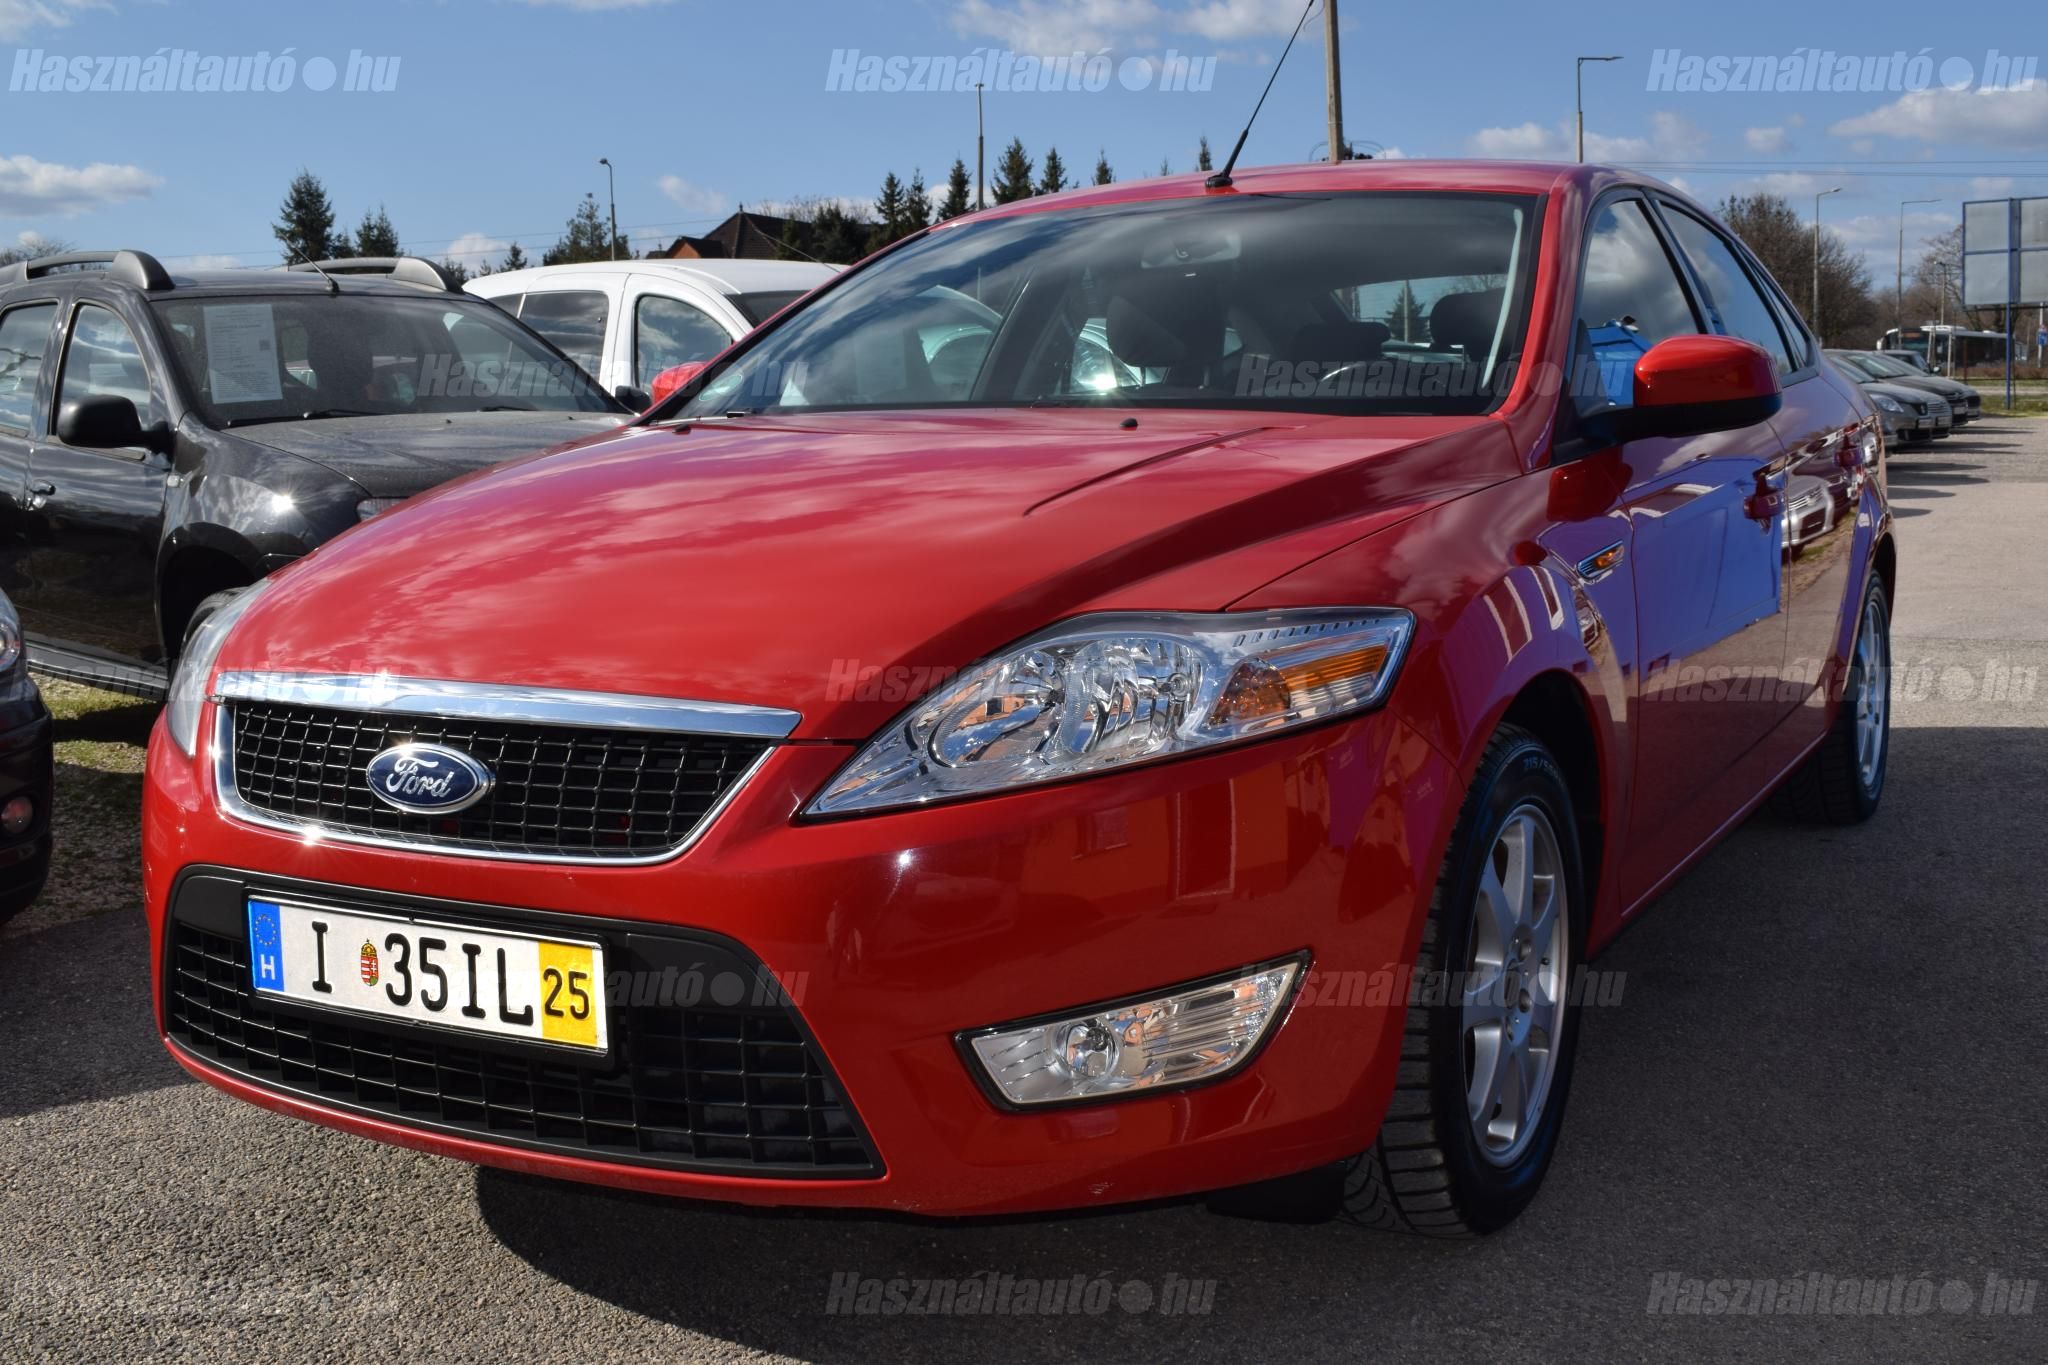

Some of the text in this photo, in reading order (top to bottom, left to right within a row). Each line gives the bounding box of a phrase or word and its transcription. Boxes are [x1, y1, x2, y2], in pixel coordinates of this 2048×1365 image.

[385, 756, 454, 797] Ford
[259, 954, 276, 980] H
[543, 967, 590, 1020] 25
